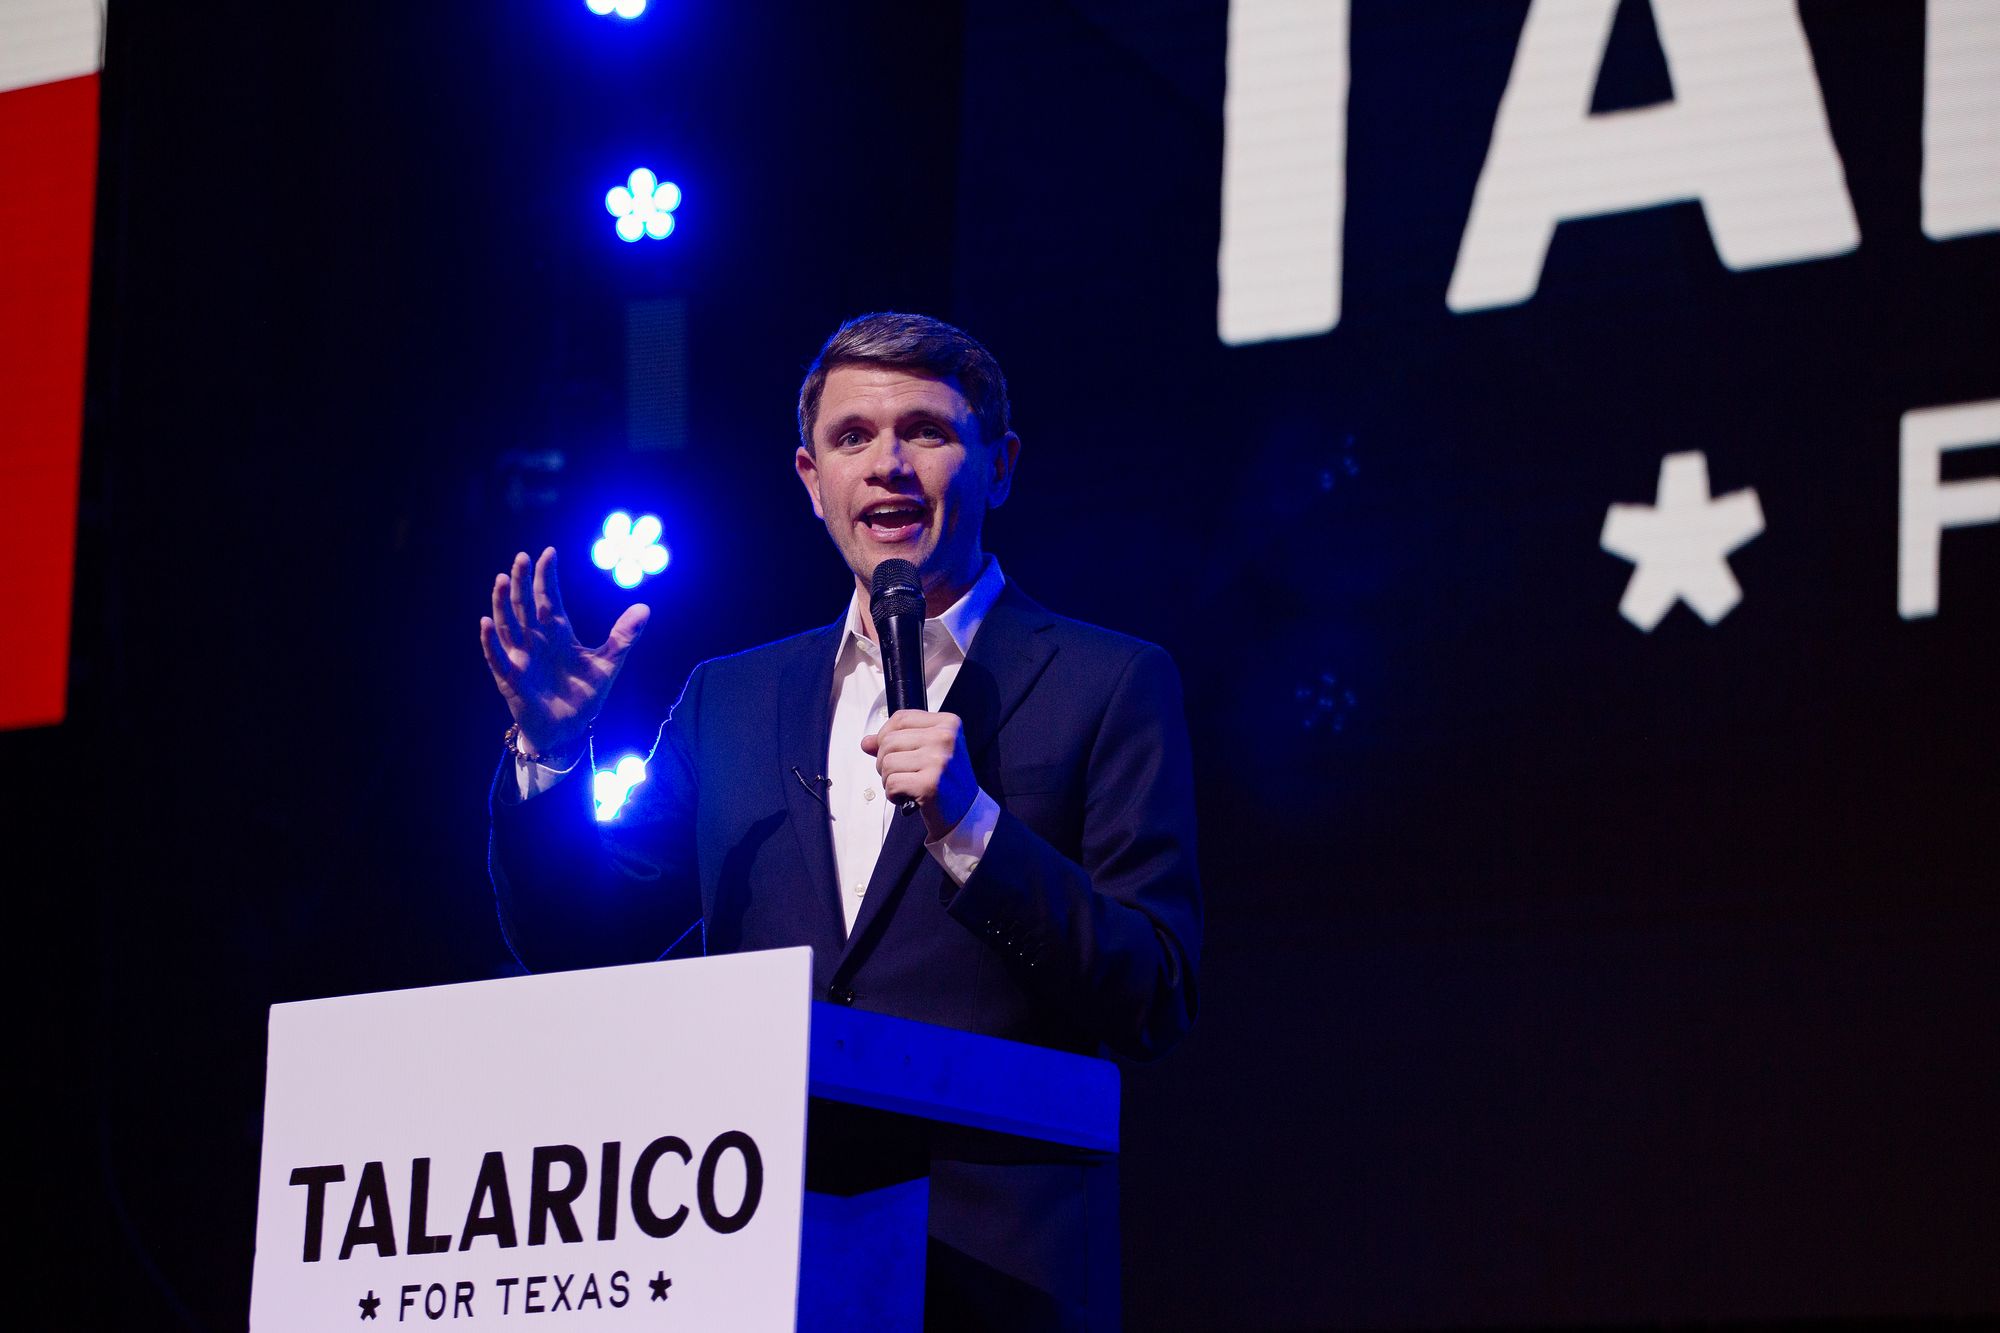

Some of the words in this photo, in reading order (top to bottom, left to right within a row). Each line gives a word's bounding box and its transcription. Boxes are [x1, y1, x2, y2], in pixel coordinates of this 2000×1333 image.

[289, 1130, 764, 1263] TALARICO
[399, 1281, 475, 1322] FOR
[496, 1270, 631, 1315] TEXAS
